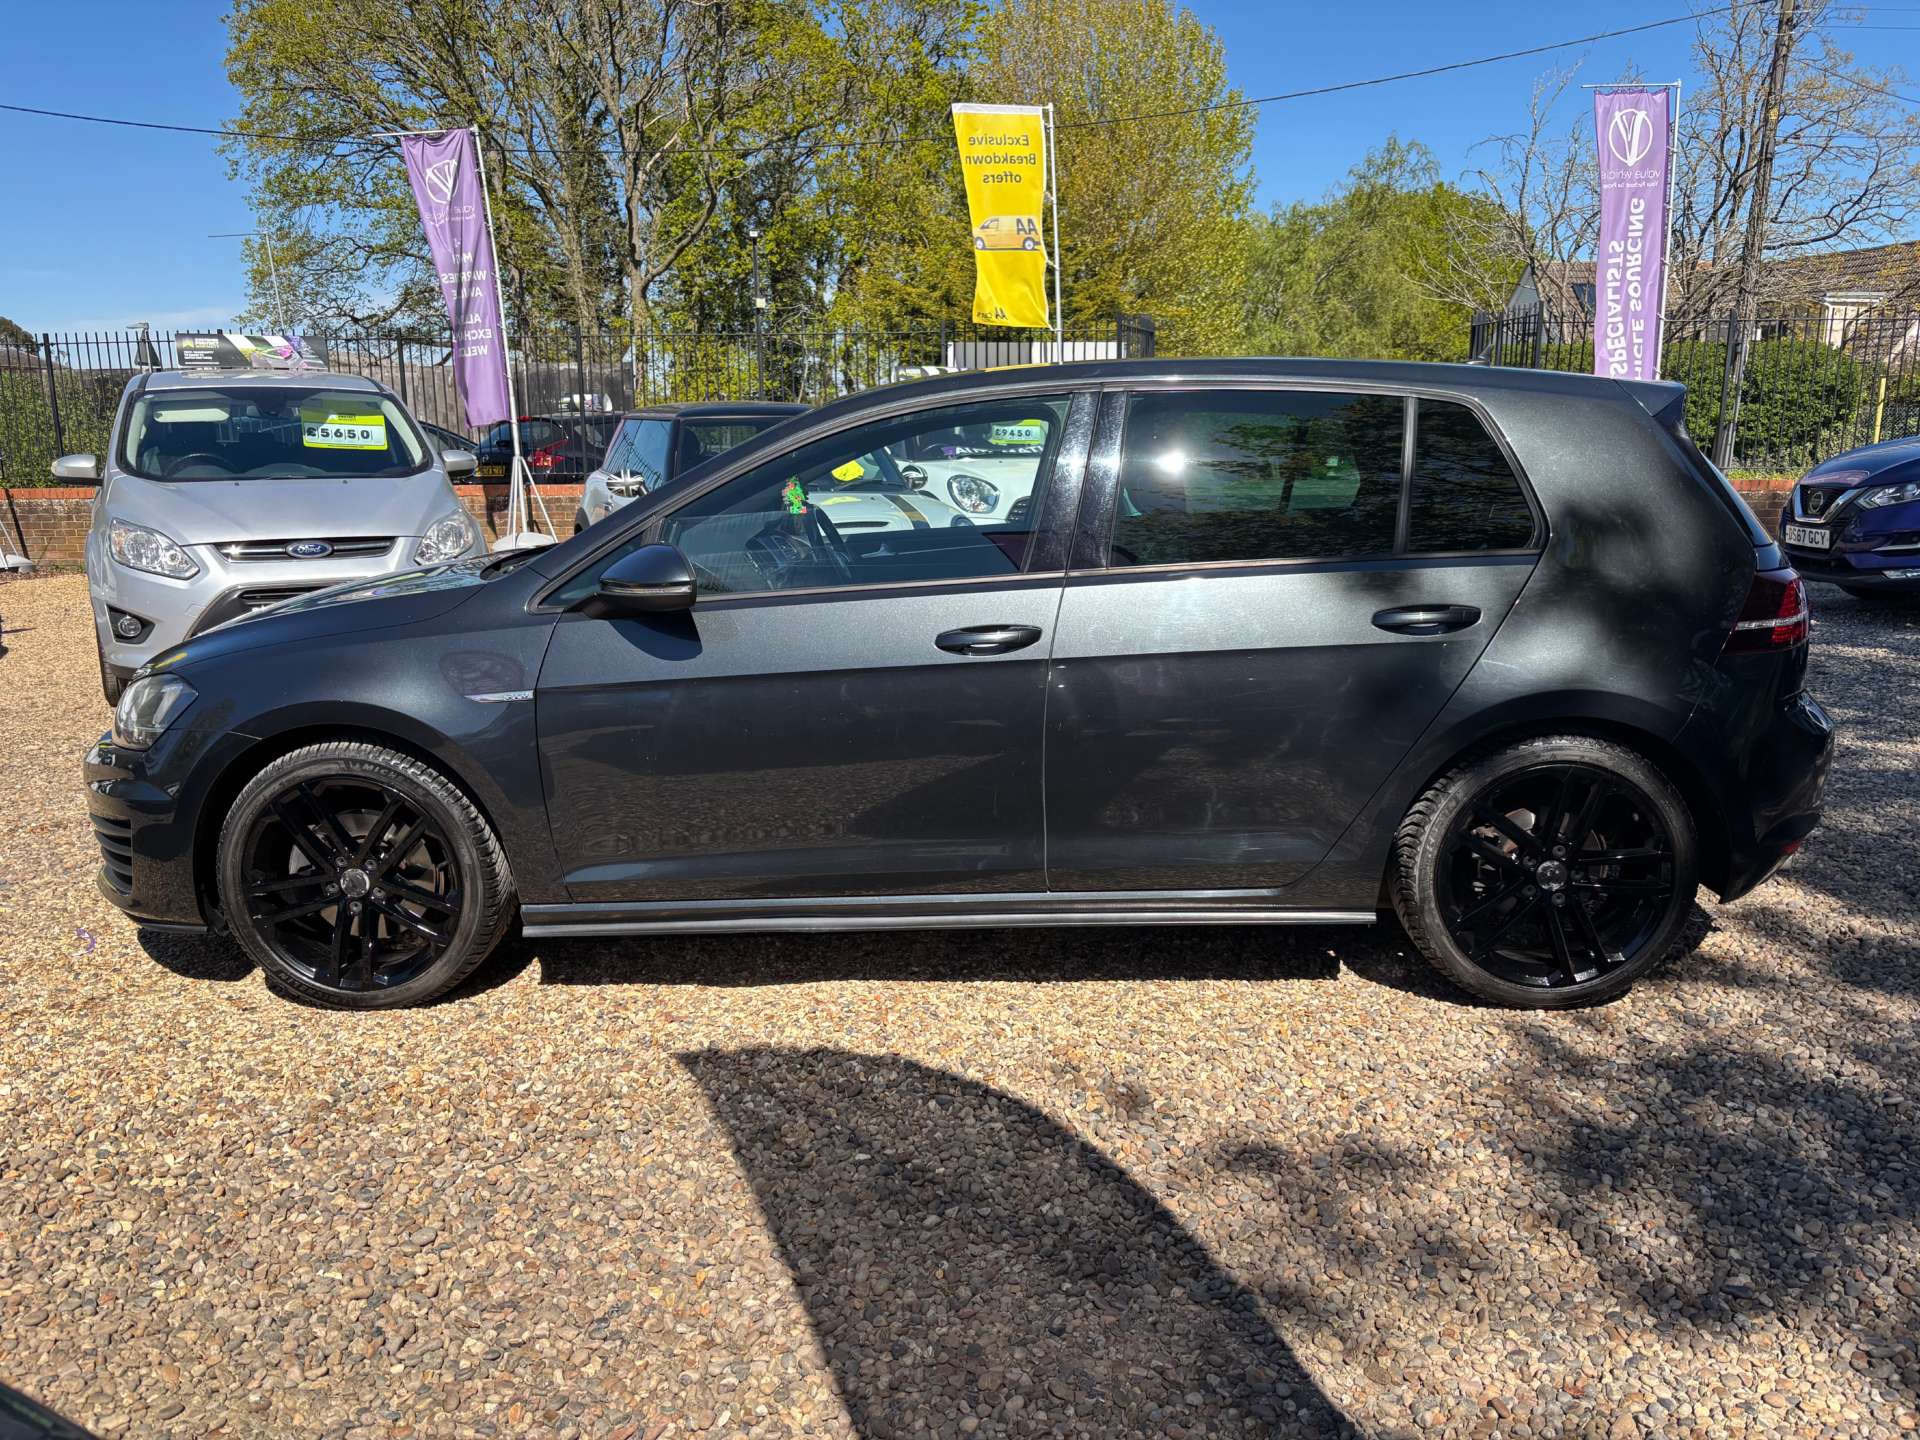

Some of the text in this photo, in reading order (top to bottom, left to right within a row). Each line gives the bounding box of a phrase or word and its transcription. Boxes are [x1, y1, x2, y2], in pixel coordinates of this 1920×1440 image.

[306, 427, 370, 440] £5650
[994, 428, 1032, 437] £9450
[1808, 530, 1827, 546] GCY
[296, 544, 321, 554] Ford
